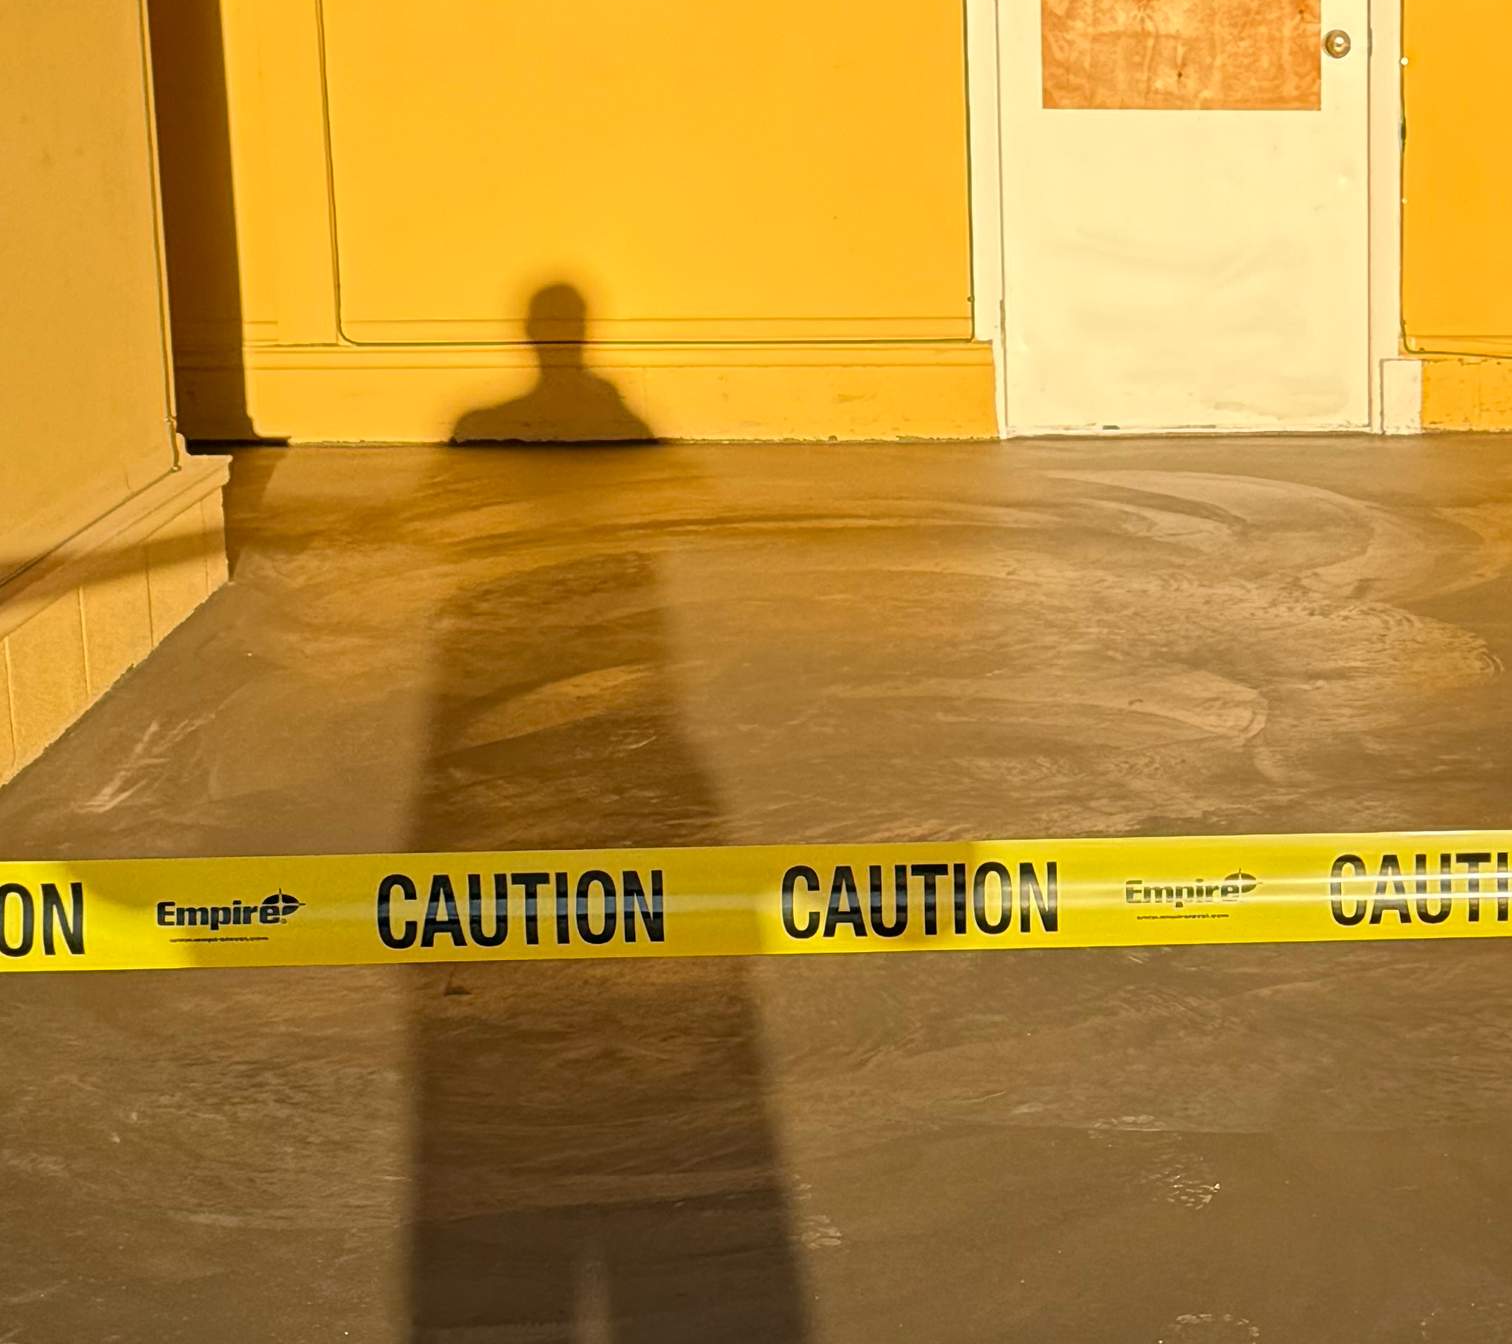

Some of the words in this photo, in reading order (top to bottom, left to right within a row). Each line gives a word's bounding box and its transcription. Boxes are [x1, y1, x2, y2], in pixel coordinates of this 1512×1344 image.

[156, 899, 281, 931] Empire
[377, 870, 664, 949] CAUTION
[781, 861, 1058, 939] CAUTION
[1125, 878, 1240, 908] Empire
